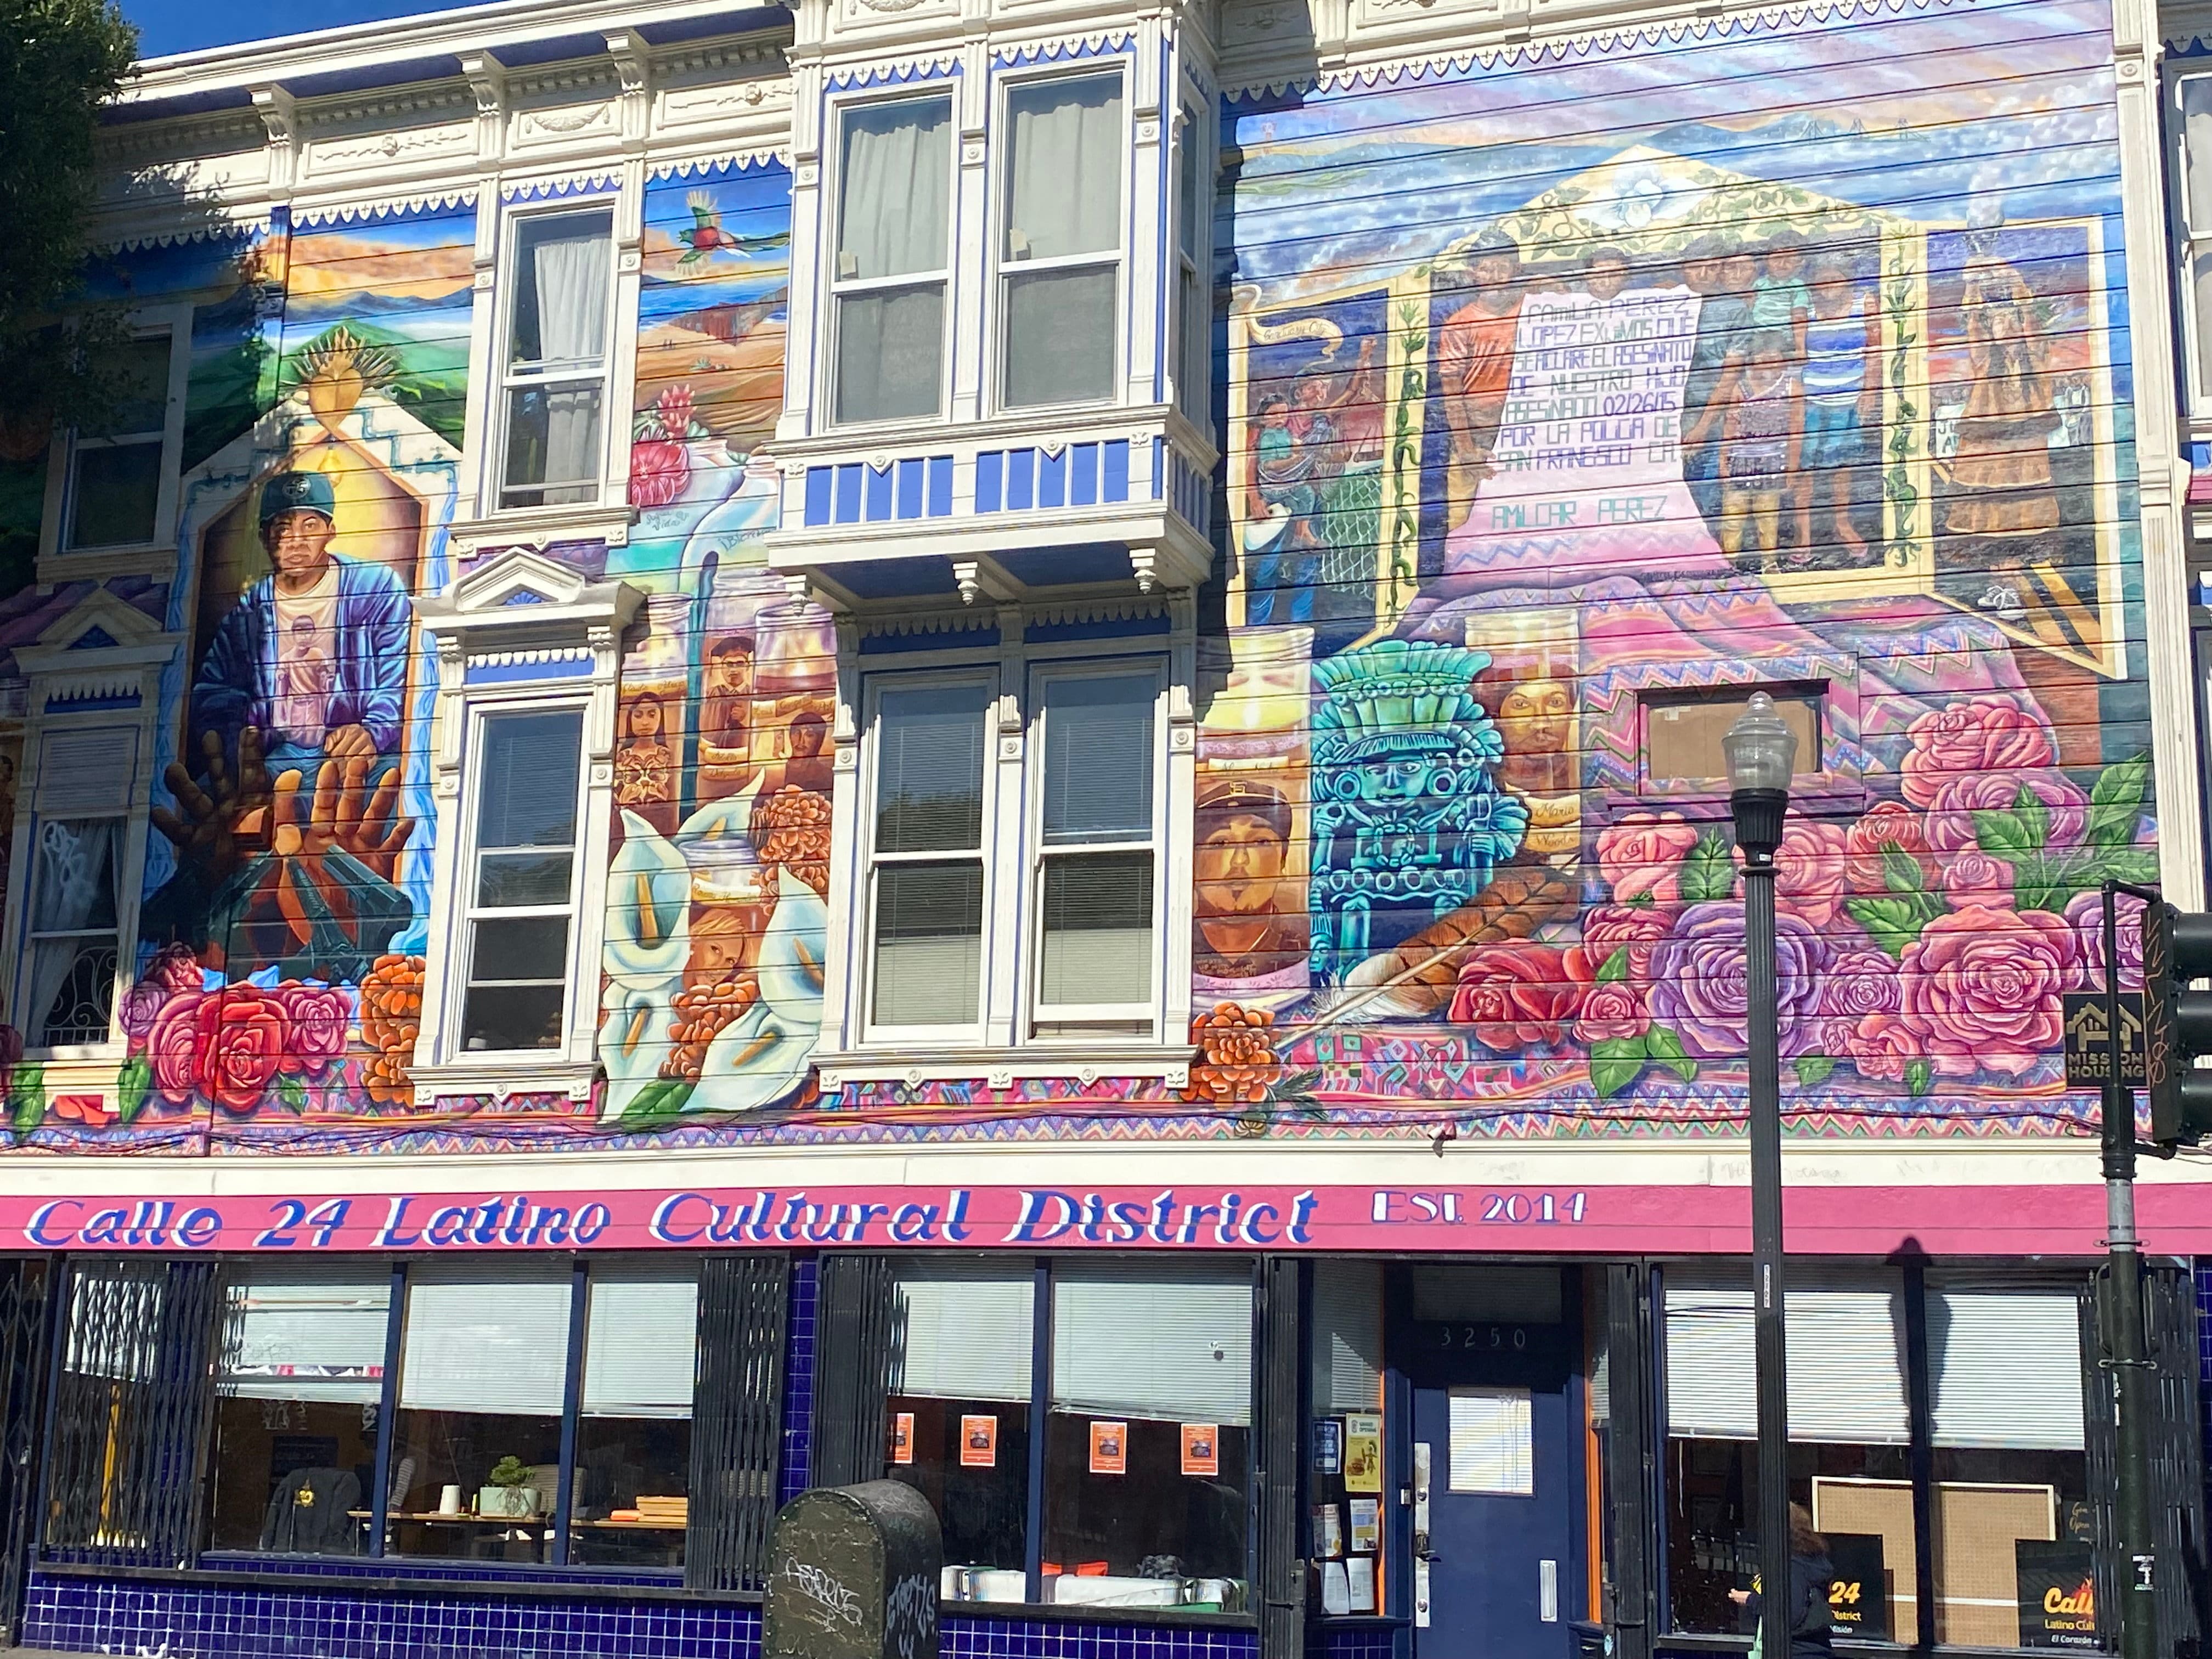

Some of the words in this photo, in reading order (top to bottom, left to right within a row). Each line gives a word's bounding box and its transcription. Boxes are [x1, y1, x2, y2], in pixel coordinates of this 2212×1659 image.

[1610, 294, 1690, 319] PEREZ
[1519, 324, 1577, 348] LOPEZ
[1592, 347, 1612, 368] EL
[1550, 368, 1632, 396] NUESTRO
[1603, 391, 1677, 416] 02/26/15
[1500, 426, 1536, 448] POR
[1547, 422, 1570, 445] LA
[1654, 415, 1678, 438] DE
[1492, 500, 1577, 529] AMILCAR
[1597, 495, 1668, 523] PEREZ
[2068, 1052, 2144, 1065] MISSON
[2069, 1066, 2145, 1079] HOUSNG
[1480, 1190, 1589, 1223] 2014
[22, 1199, 223, 1249] Calle
[252, 1198, 353, 1248] 24
[369, 1194, 611, 1247] Latino
[648, 1189, 972, 1244] Cultural
[1000, 1189, 1319, 1245] District
[1440, 1326, 1527, 1348] 3250
[1829, 1581, 1861, 1604] 24
[2044, 1587, 2094, 1615] Call
[1831, 1610, 1862, 1622] istrict
[2044, 1618, 2075, 1630] Latino
